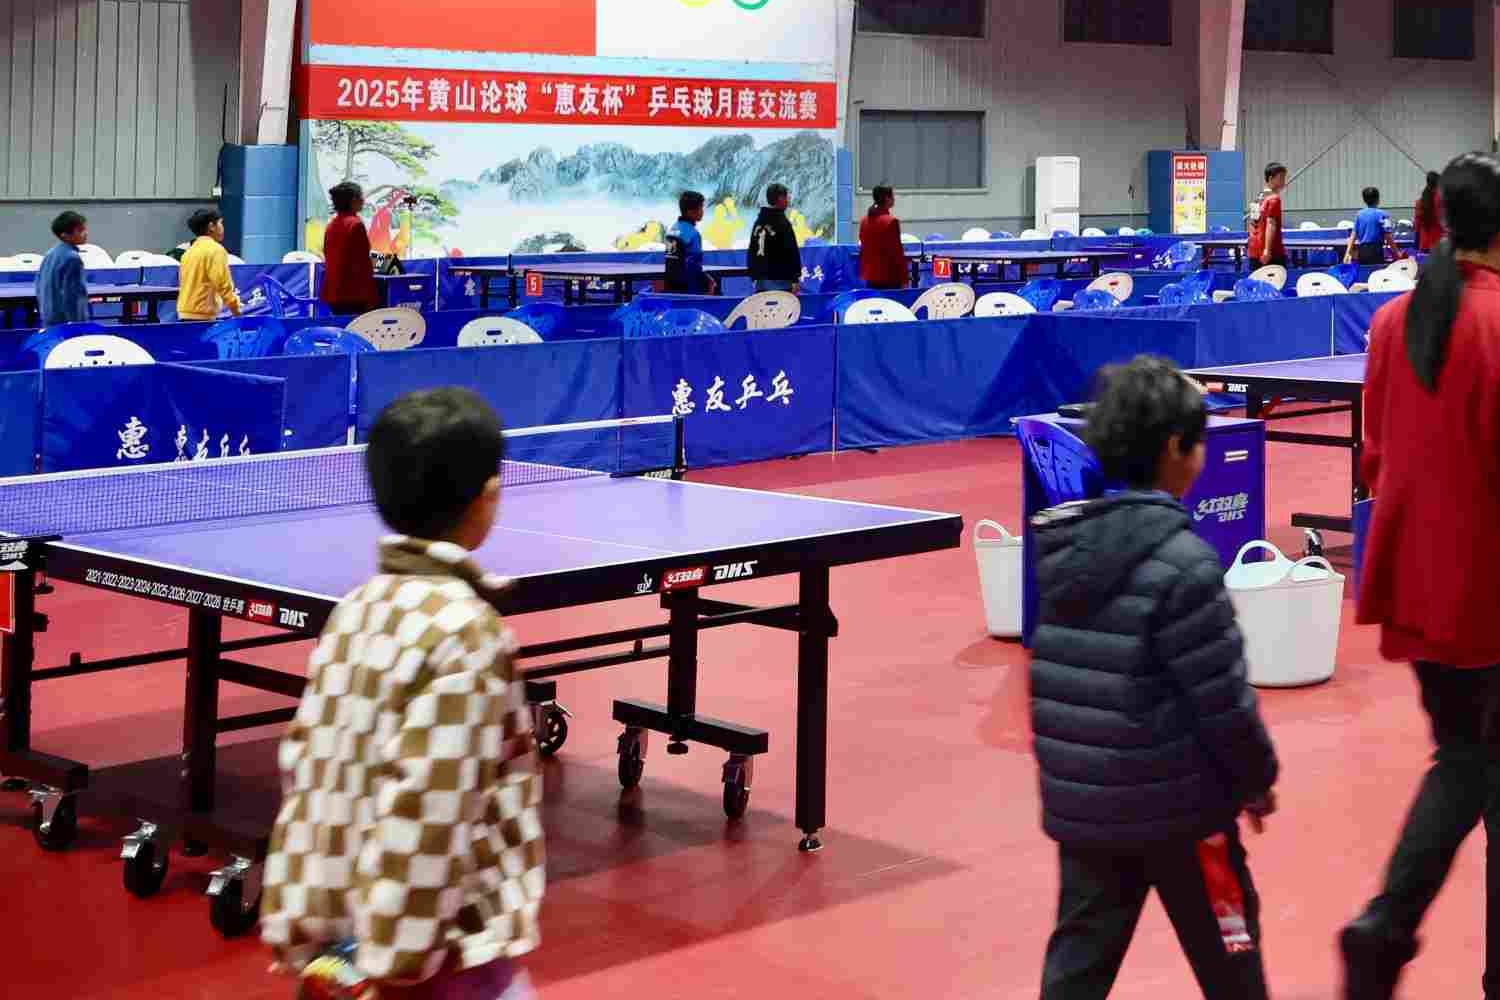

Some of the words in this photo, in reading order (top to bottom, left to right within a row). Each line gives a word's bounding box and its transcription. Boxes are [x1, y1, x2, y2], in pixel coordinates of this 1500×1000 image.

[671, 370, 794, 415] 惠友乒乓
[116, 416, 149, 460] 惠
[712, 560, 758, 581] DHS
[278, 606, 309, 628] DHS
